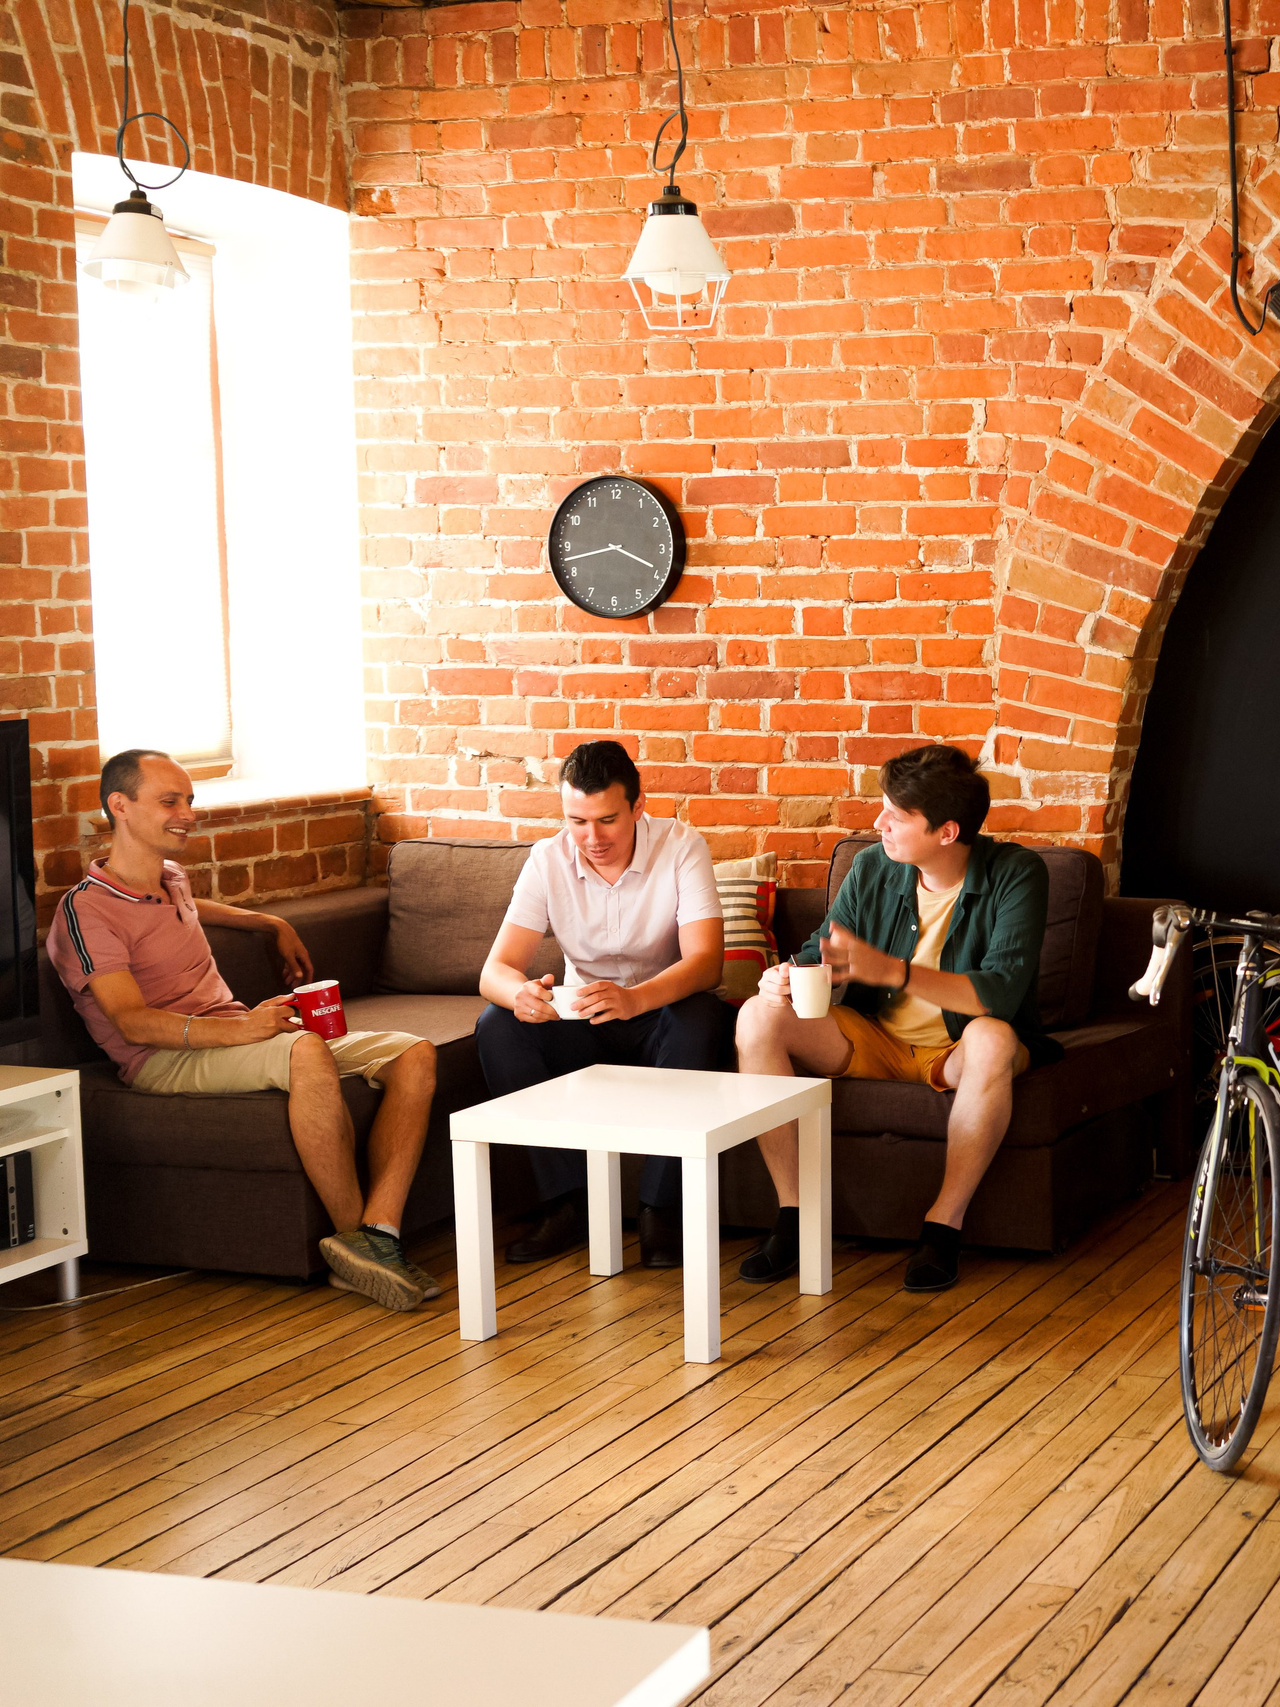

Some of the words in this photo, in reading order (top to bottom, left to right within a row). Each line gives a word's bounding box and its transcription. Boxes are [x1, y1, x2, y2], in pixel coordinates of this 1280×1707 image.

[610, 489, 621, 500] 12
[587, 497, 597, 508] 11
[638, 498, 643, 509] 1
[570, 515, 581, 526] 10
[652, 516, 659, 528] 2
[564, 541, 571, 552] 9
[659, 543, 665, 555] 3
[571, 567, 578, 577] 8
[653, 569, 660, 580] 4
[588, 587, 595, 598] 7
[635, 589, 642, 600] 5
[611, 596, 618, 607] 6
